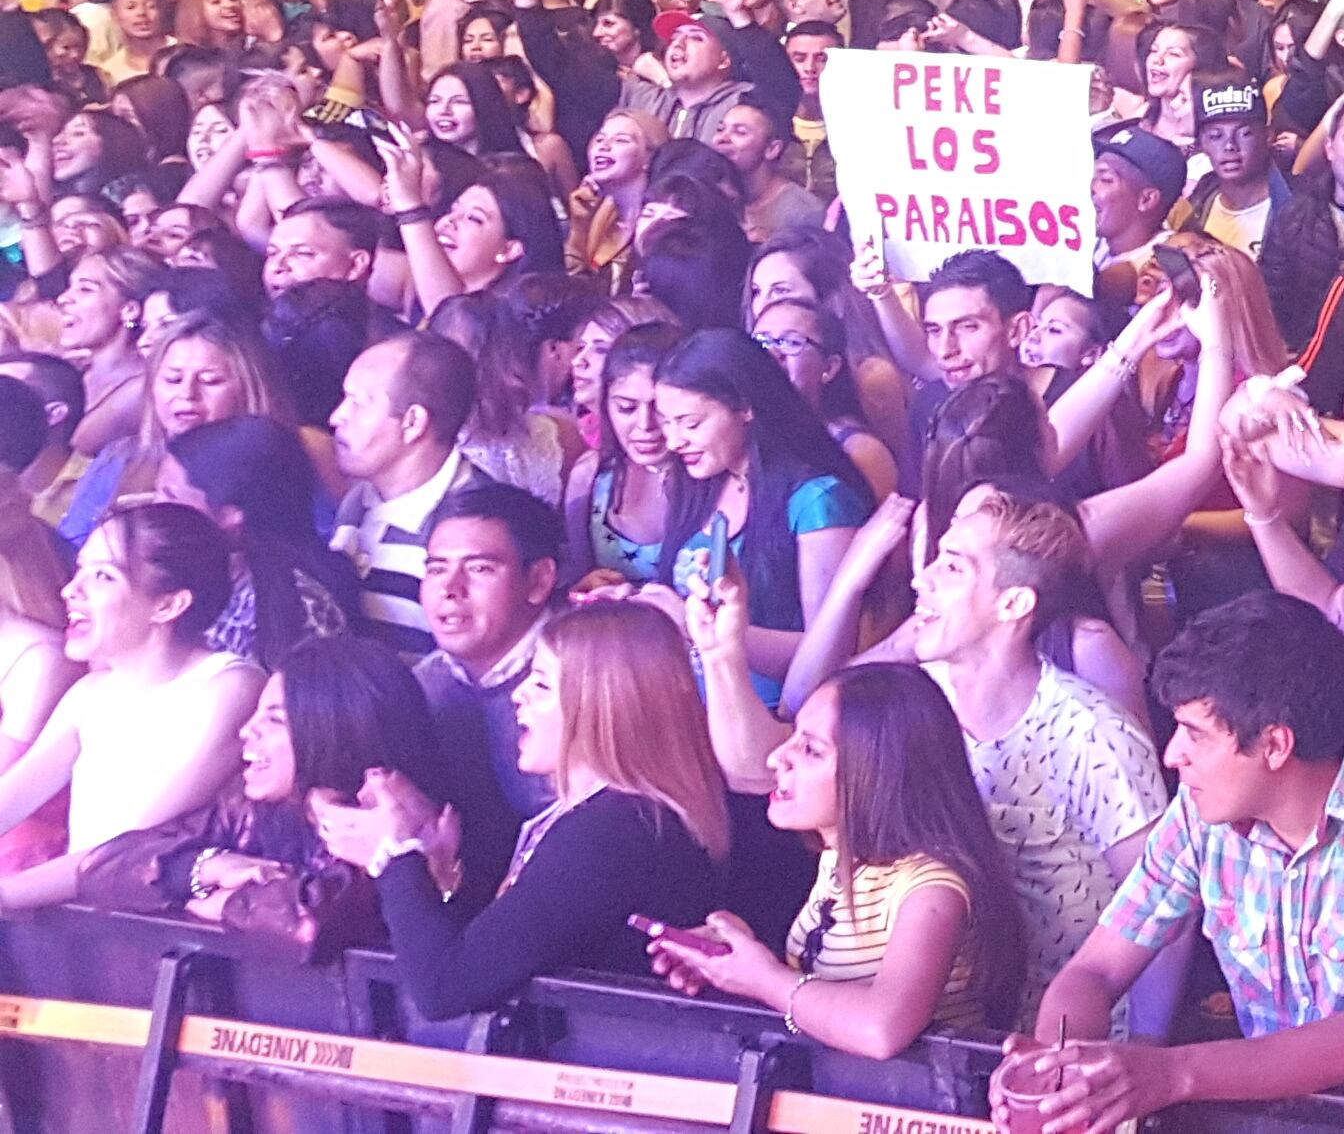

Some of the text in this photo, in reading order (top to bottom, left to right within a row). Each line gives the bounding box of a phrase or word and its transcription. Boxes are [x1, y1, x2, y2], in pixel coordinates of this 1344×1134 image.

[892, 63, 1001, 115] PEKE
[906, 125, 1001, 175] LOS
[875, 192, 1082, 252] PARAISOS
[210, 1026, 310, 1063] KINEDYNE
